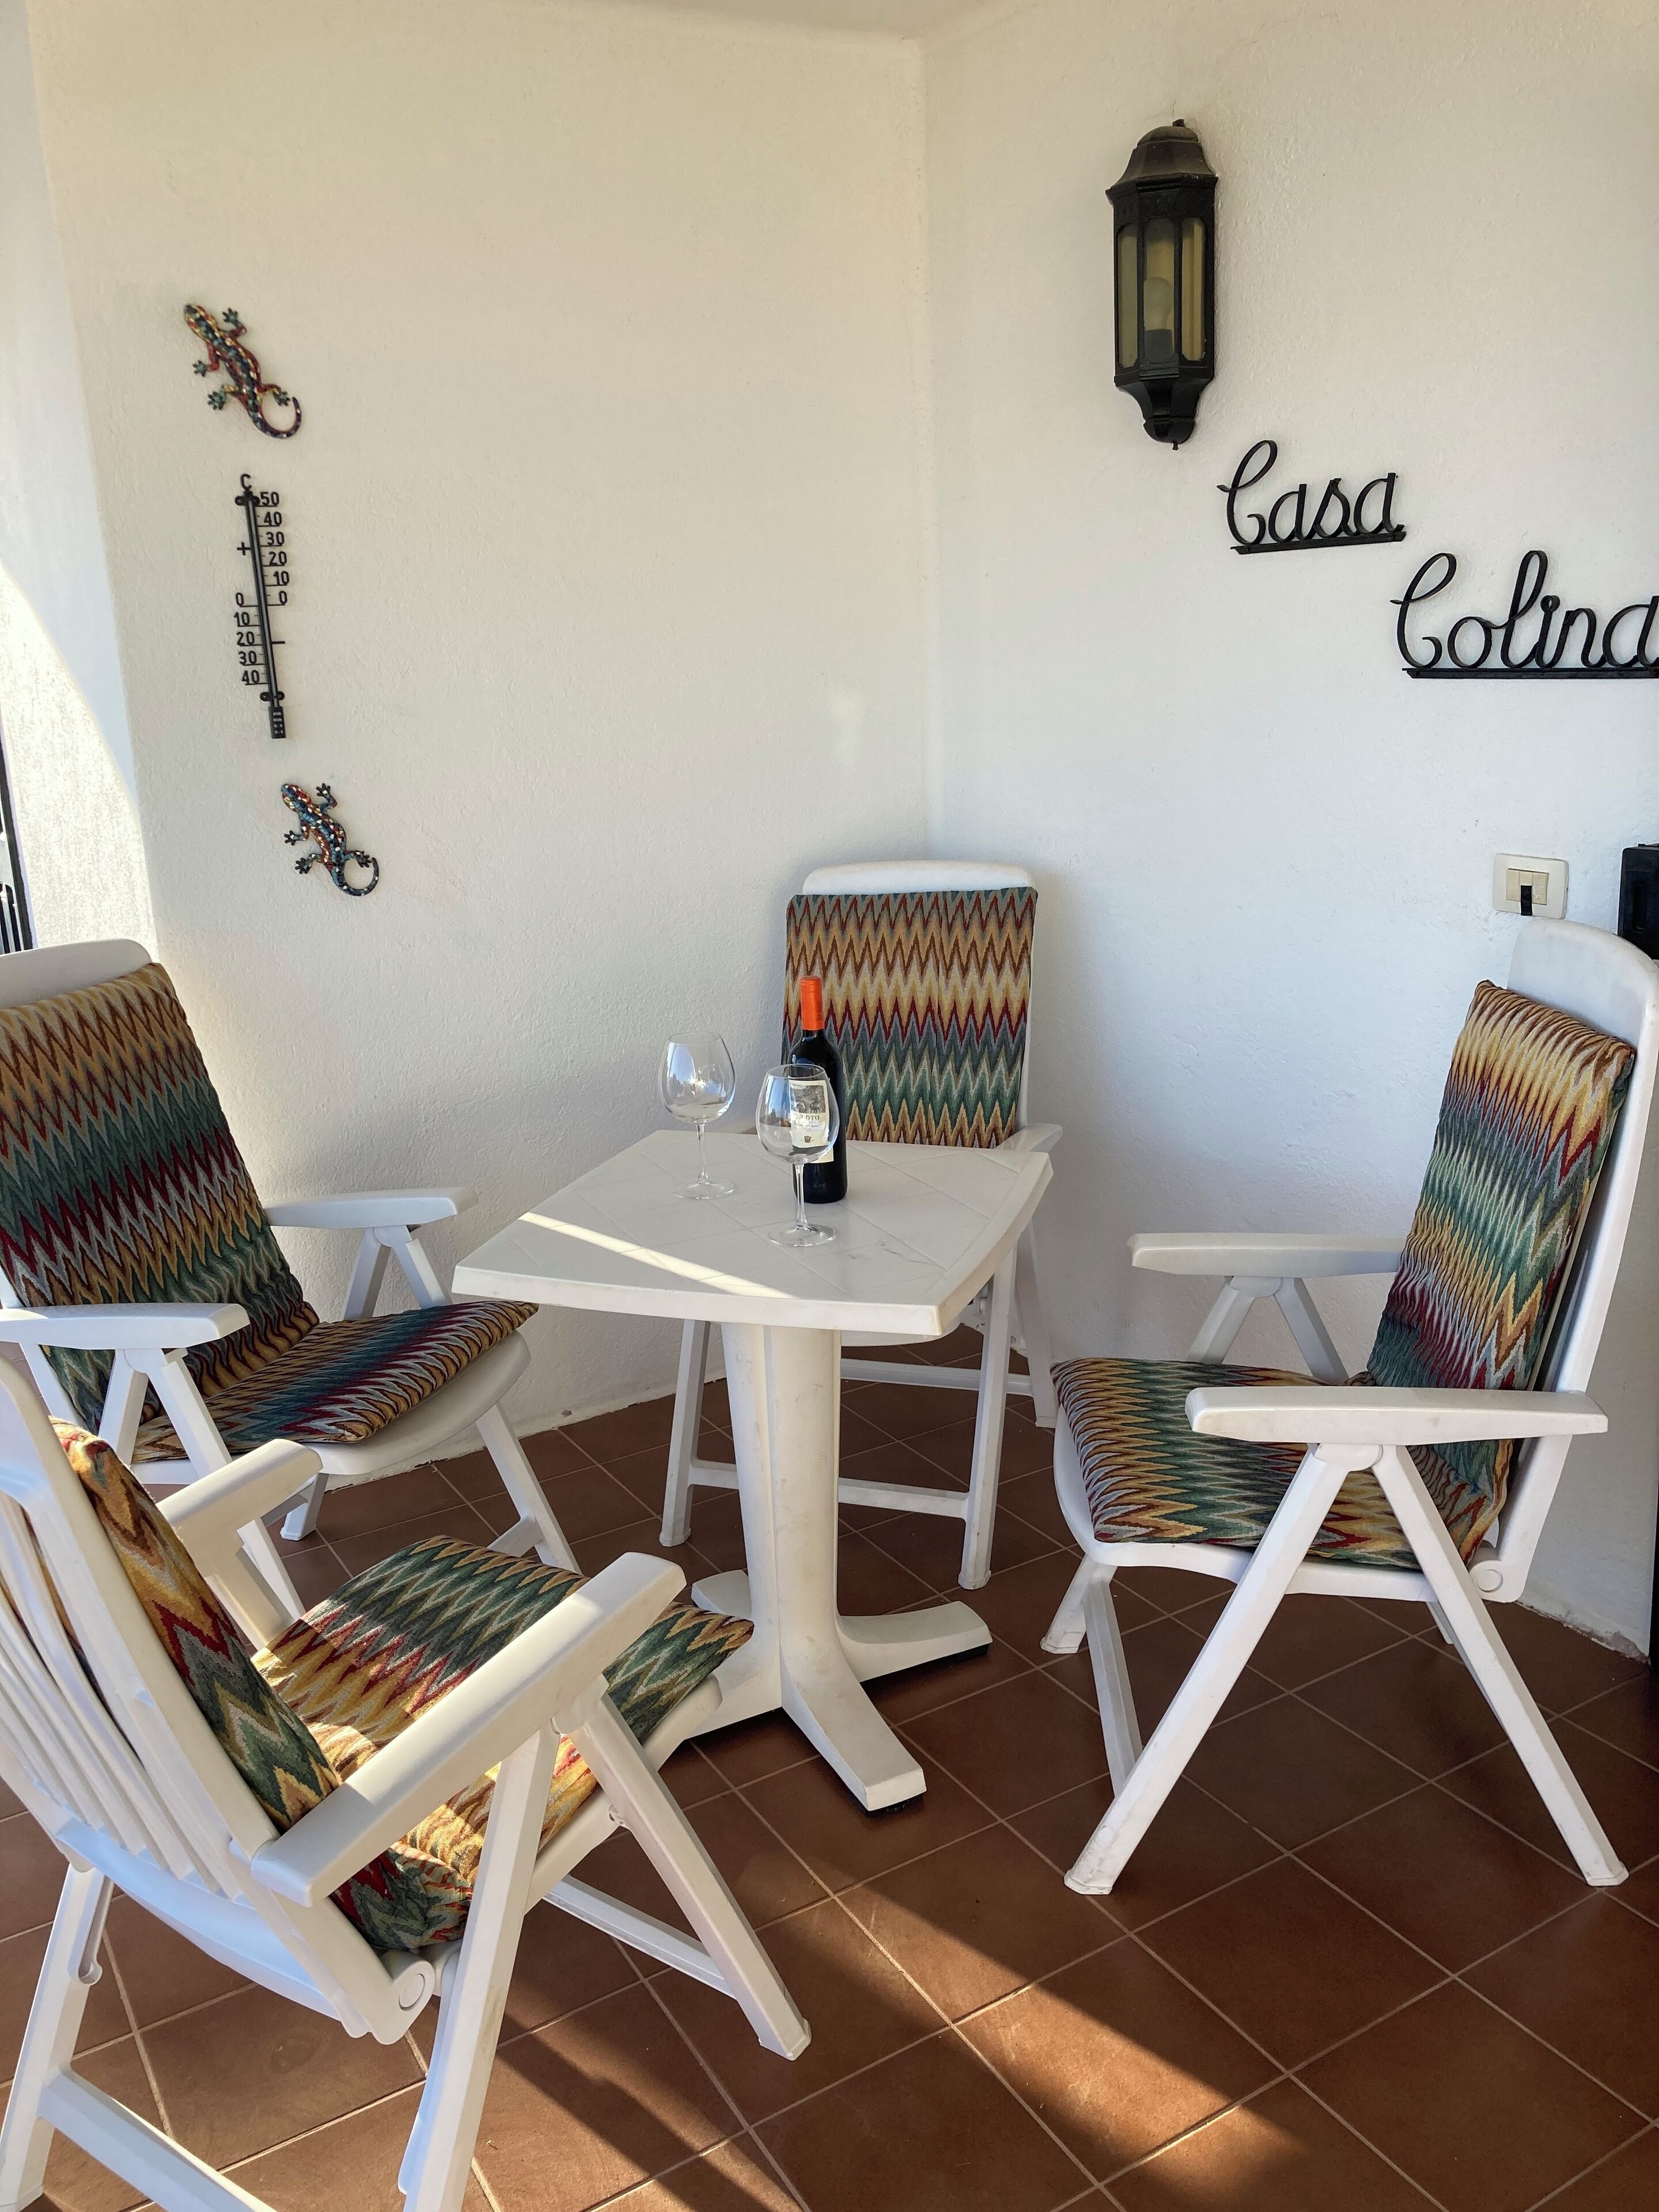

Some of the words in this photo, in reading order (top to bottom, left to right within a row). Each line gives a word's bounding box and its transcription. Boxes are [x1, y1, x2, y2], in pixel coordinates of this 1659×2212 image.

[260, 492, 279, 506] 50
[1217, 440, 1404, 544] Casa
[264, 512, 282, 526] 40
[266, 532, 285, 546] 30
[269, 551, 287, 566] 20
[274, 571, 290, 585] 10
[235, 592, 244, 606] 0
[279, 590, 287, 605] 0
[1389, 550, 1659, 669] Colina
[234, 612, 250, 626] 10
[236, 631, 255, 645] 20
[238, 651, 257, 665] 30
[241, 670, 260, 684] 40
